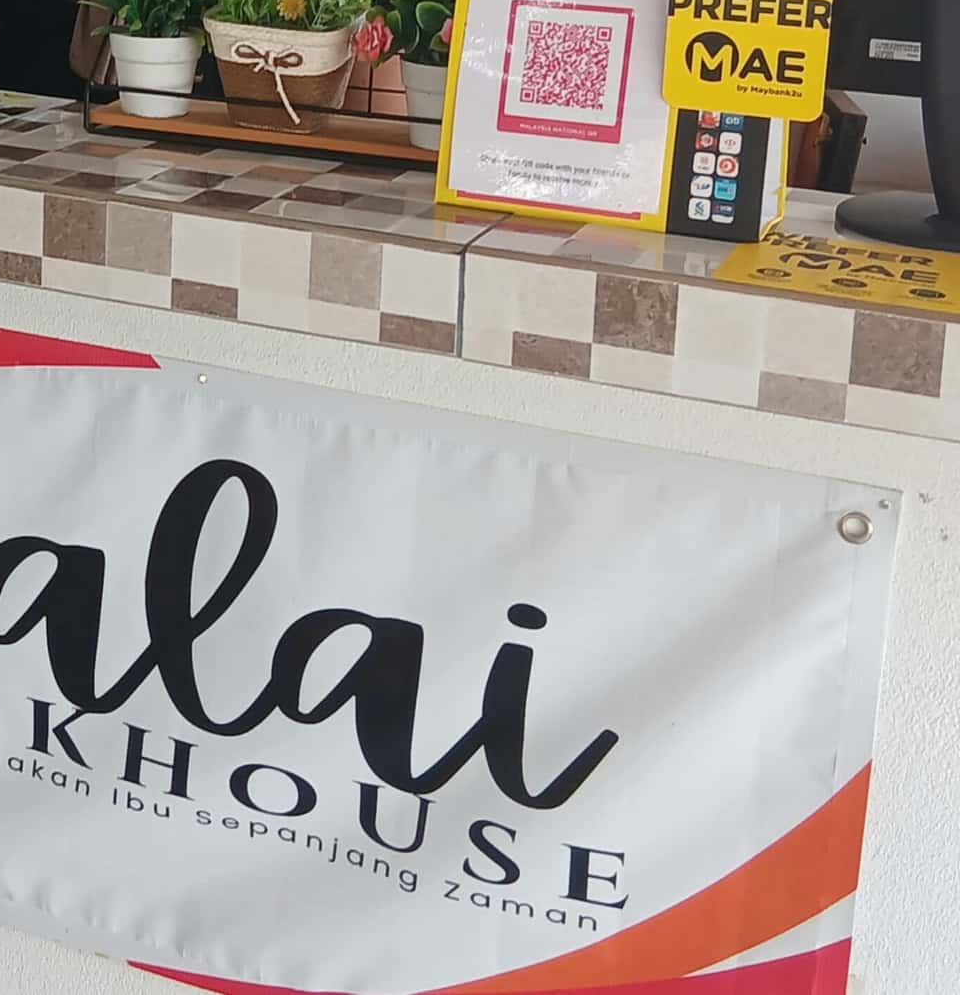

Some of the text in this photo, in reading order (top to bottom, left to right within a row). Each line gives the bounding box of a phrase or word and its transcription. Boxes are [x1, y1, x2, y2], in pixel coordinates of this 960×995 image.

[685, 30, 806, 84] MAE
[737, 84, 803, 98] by Maybank2u
[112, 788, 171, 819] Ibu
[195, 810, 419, 893] sepanjang
